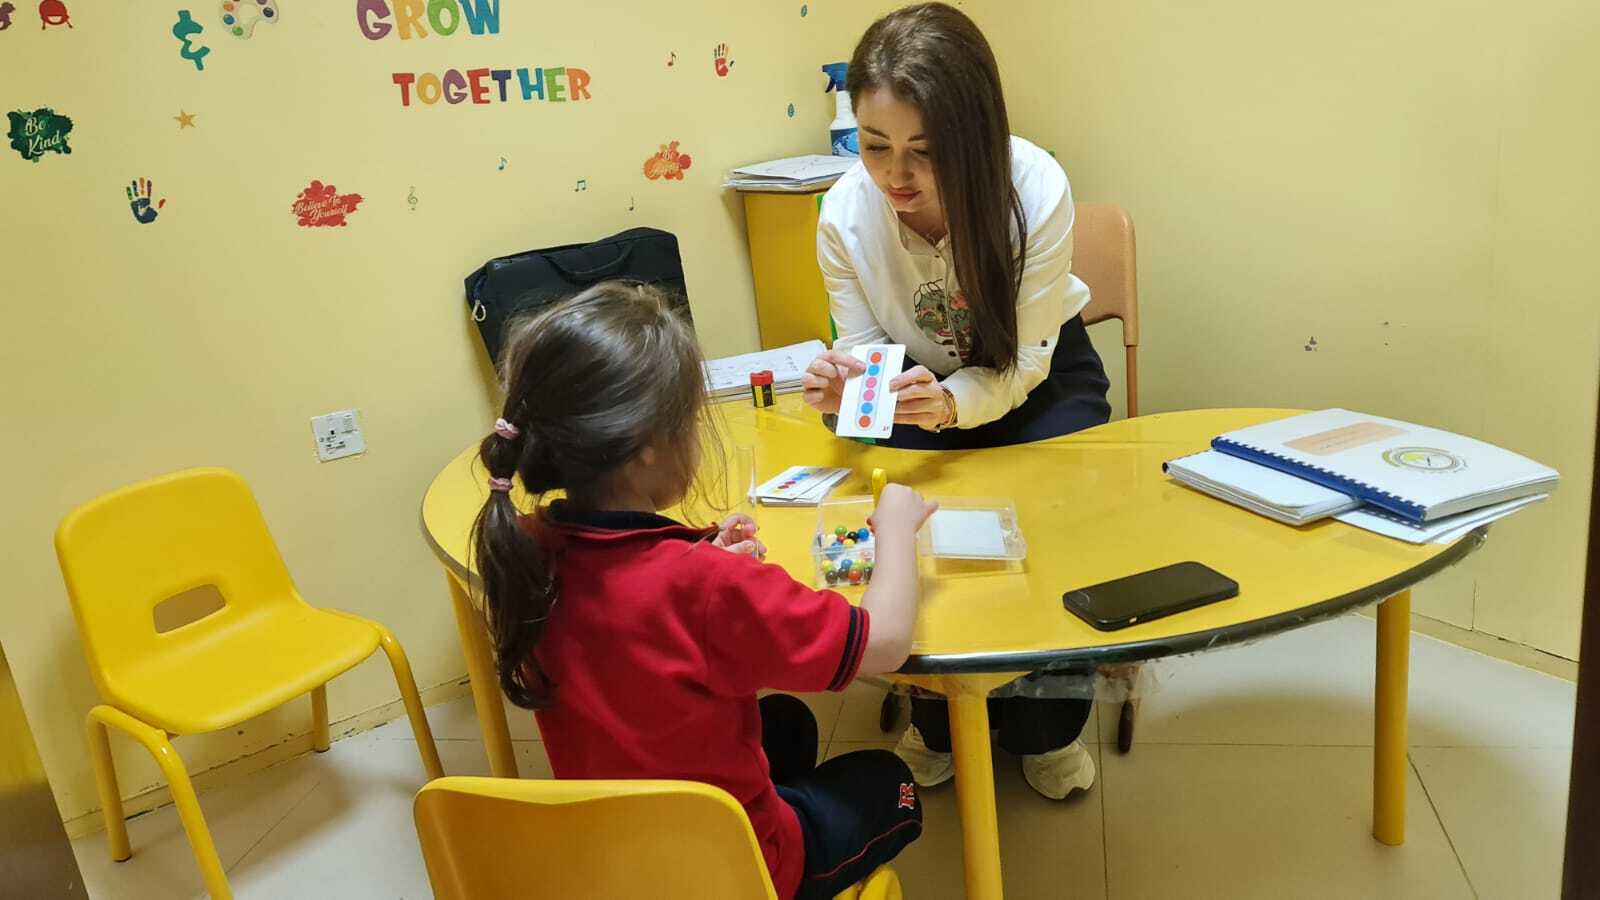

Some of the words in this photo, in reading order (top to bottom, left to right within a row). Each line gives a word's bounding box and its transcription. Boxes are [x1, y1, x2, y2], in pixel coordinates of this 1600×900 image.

[356, 0, 501, 41] GROW
[392, 67, 592, 107] TOGETHER
[25, 117, 47, 136] Be
[28, 130, 61, 157] Kind
